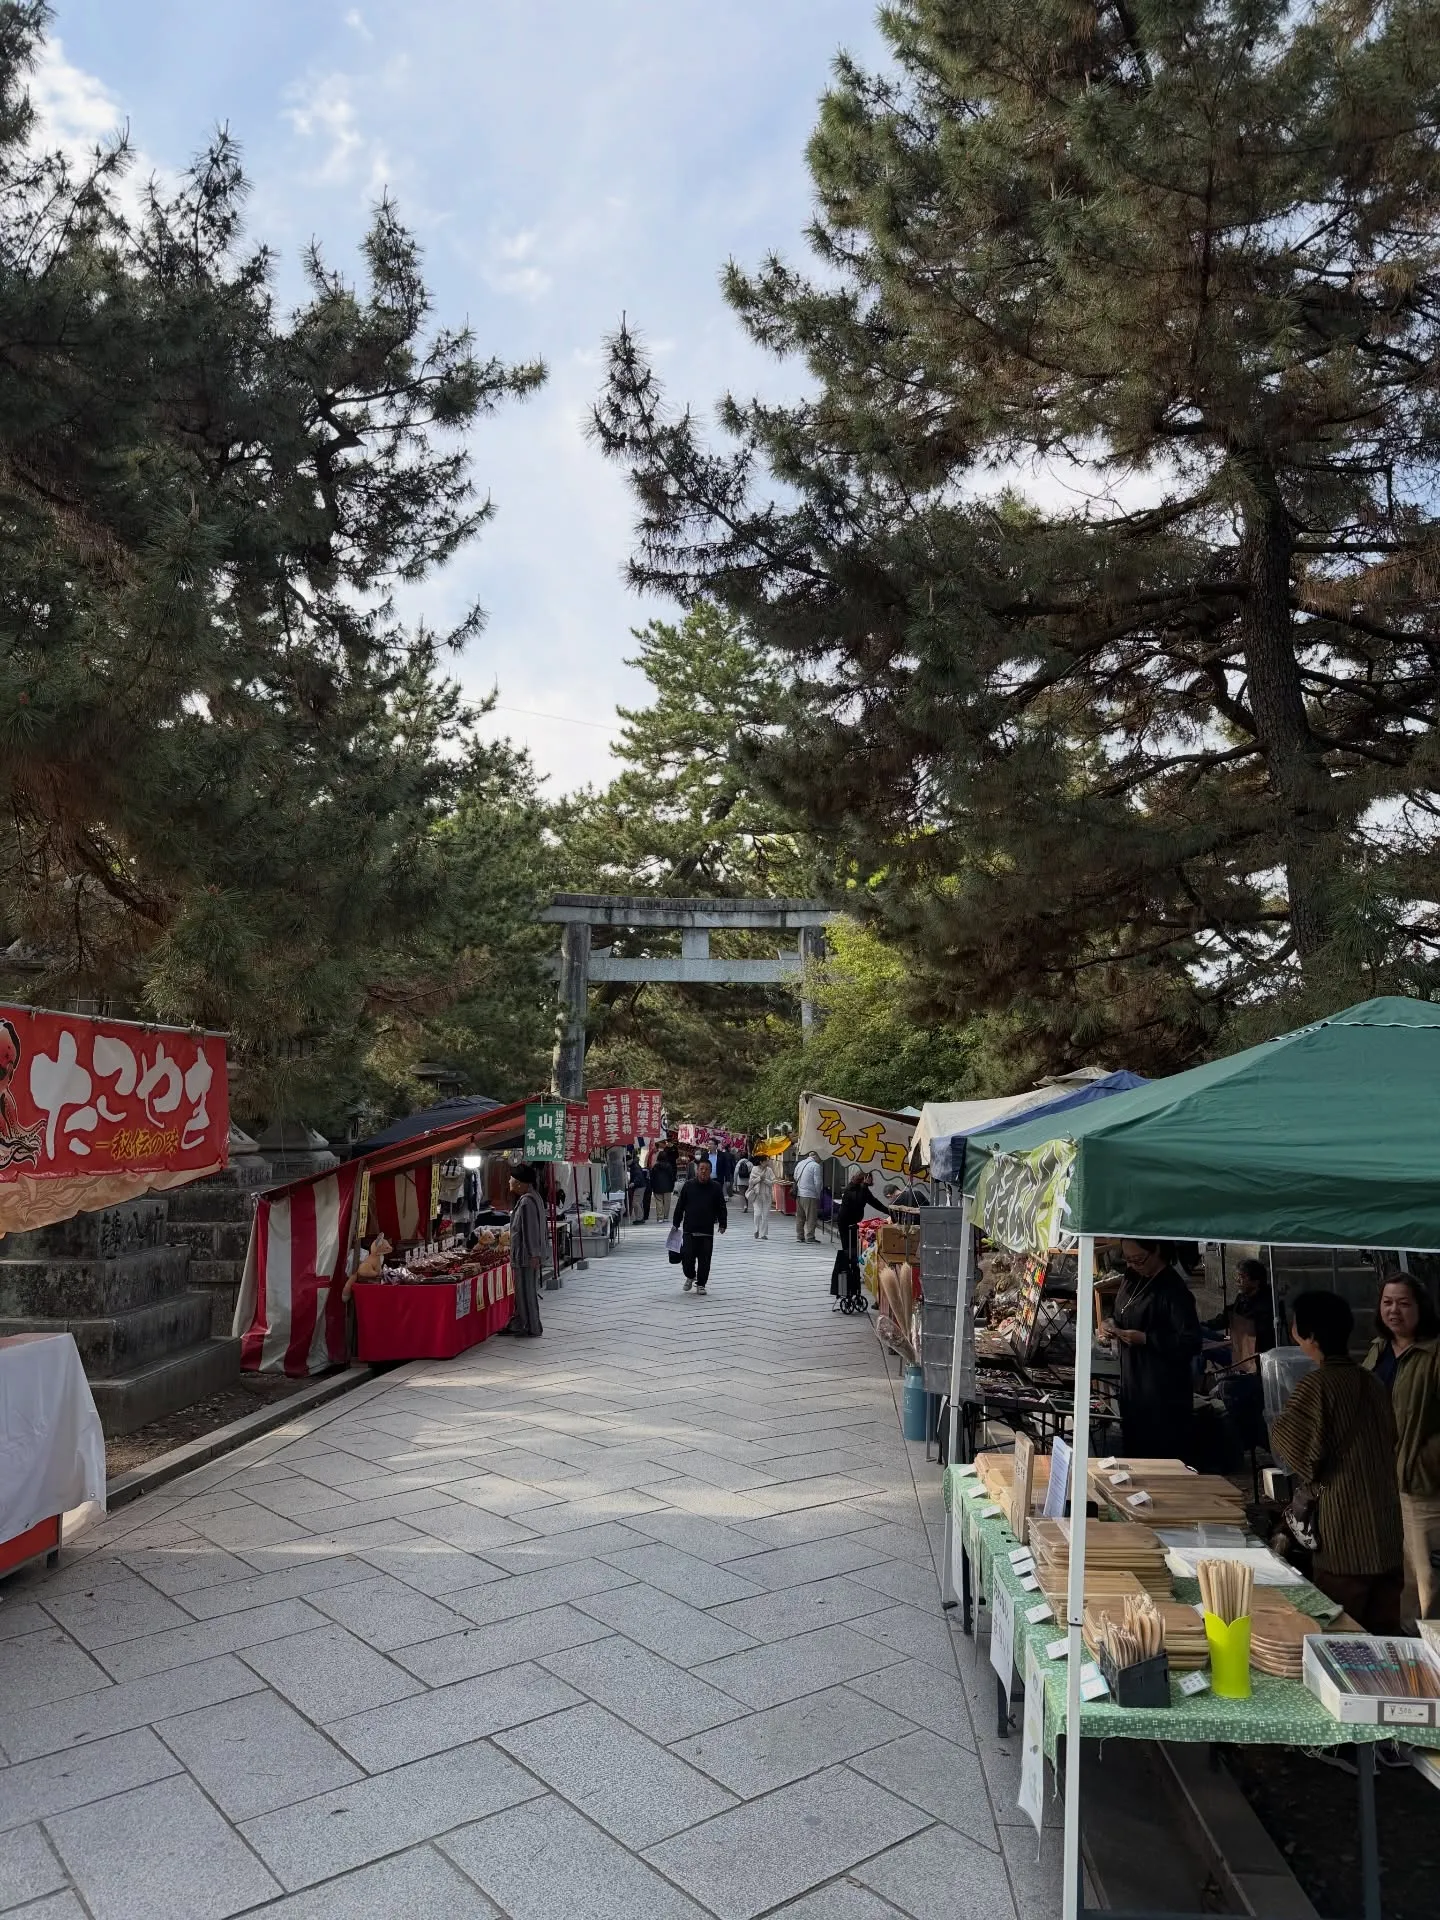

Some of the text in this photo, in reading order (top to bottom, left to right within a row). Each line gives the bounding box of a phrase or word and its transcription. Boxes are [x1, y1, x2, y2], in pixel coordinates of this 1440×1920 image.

[30, 1030, 213, 1160] たこやき
[620, 1093, 632, 1135] 稲荷名物
[637, 1093, 649, 1136] 七味唐辛子
[536, 1113, 554, 1156] 山椒
[602, 1093, 620, 1144] 七味唐辛子
[526, 1128, 536, 1157] 名物
